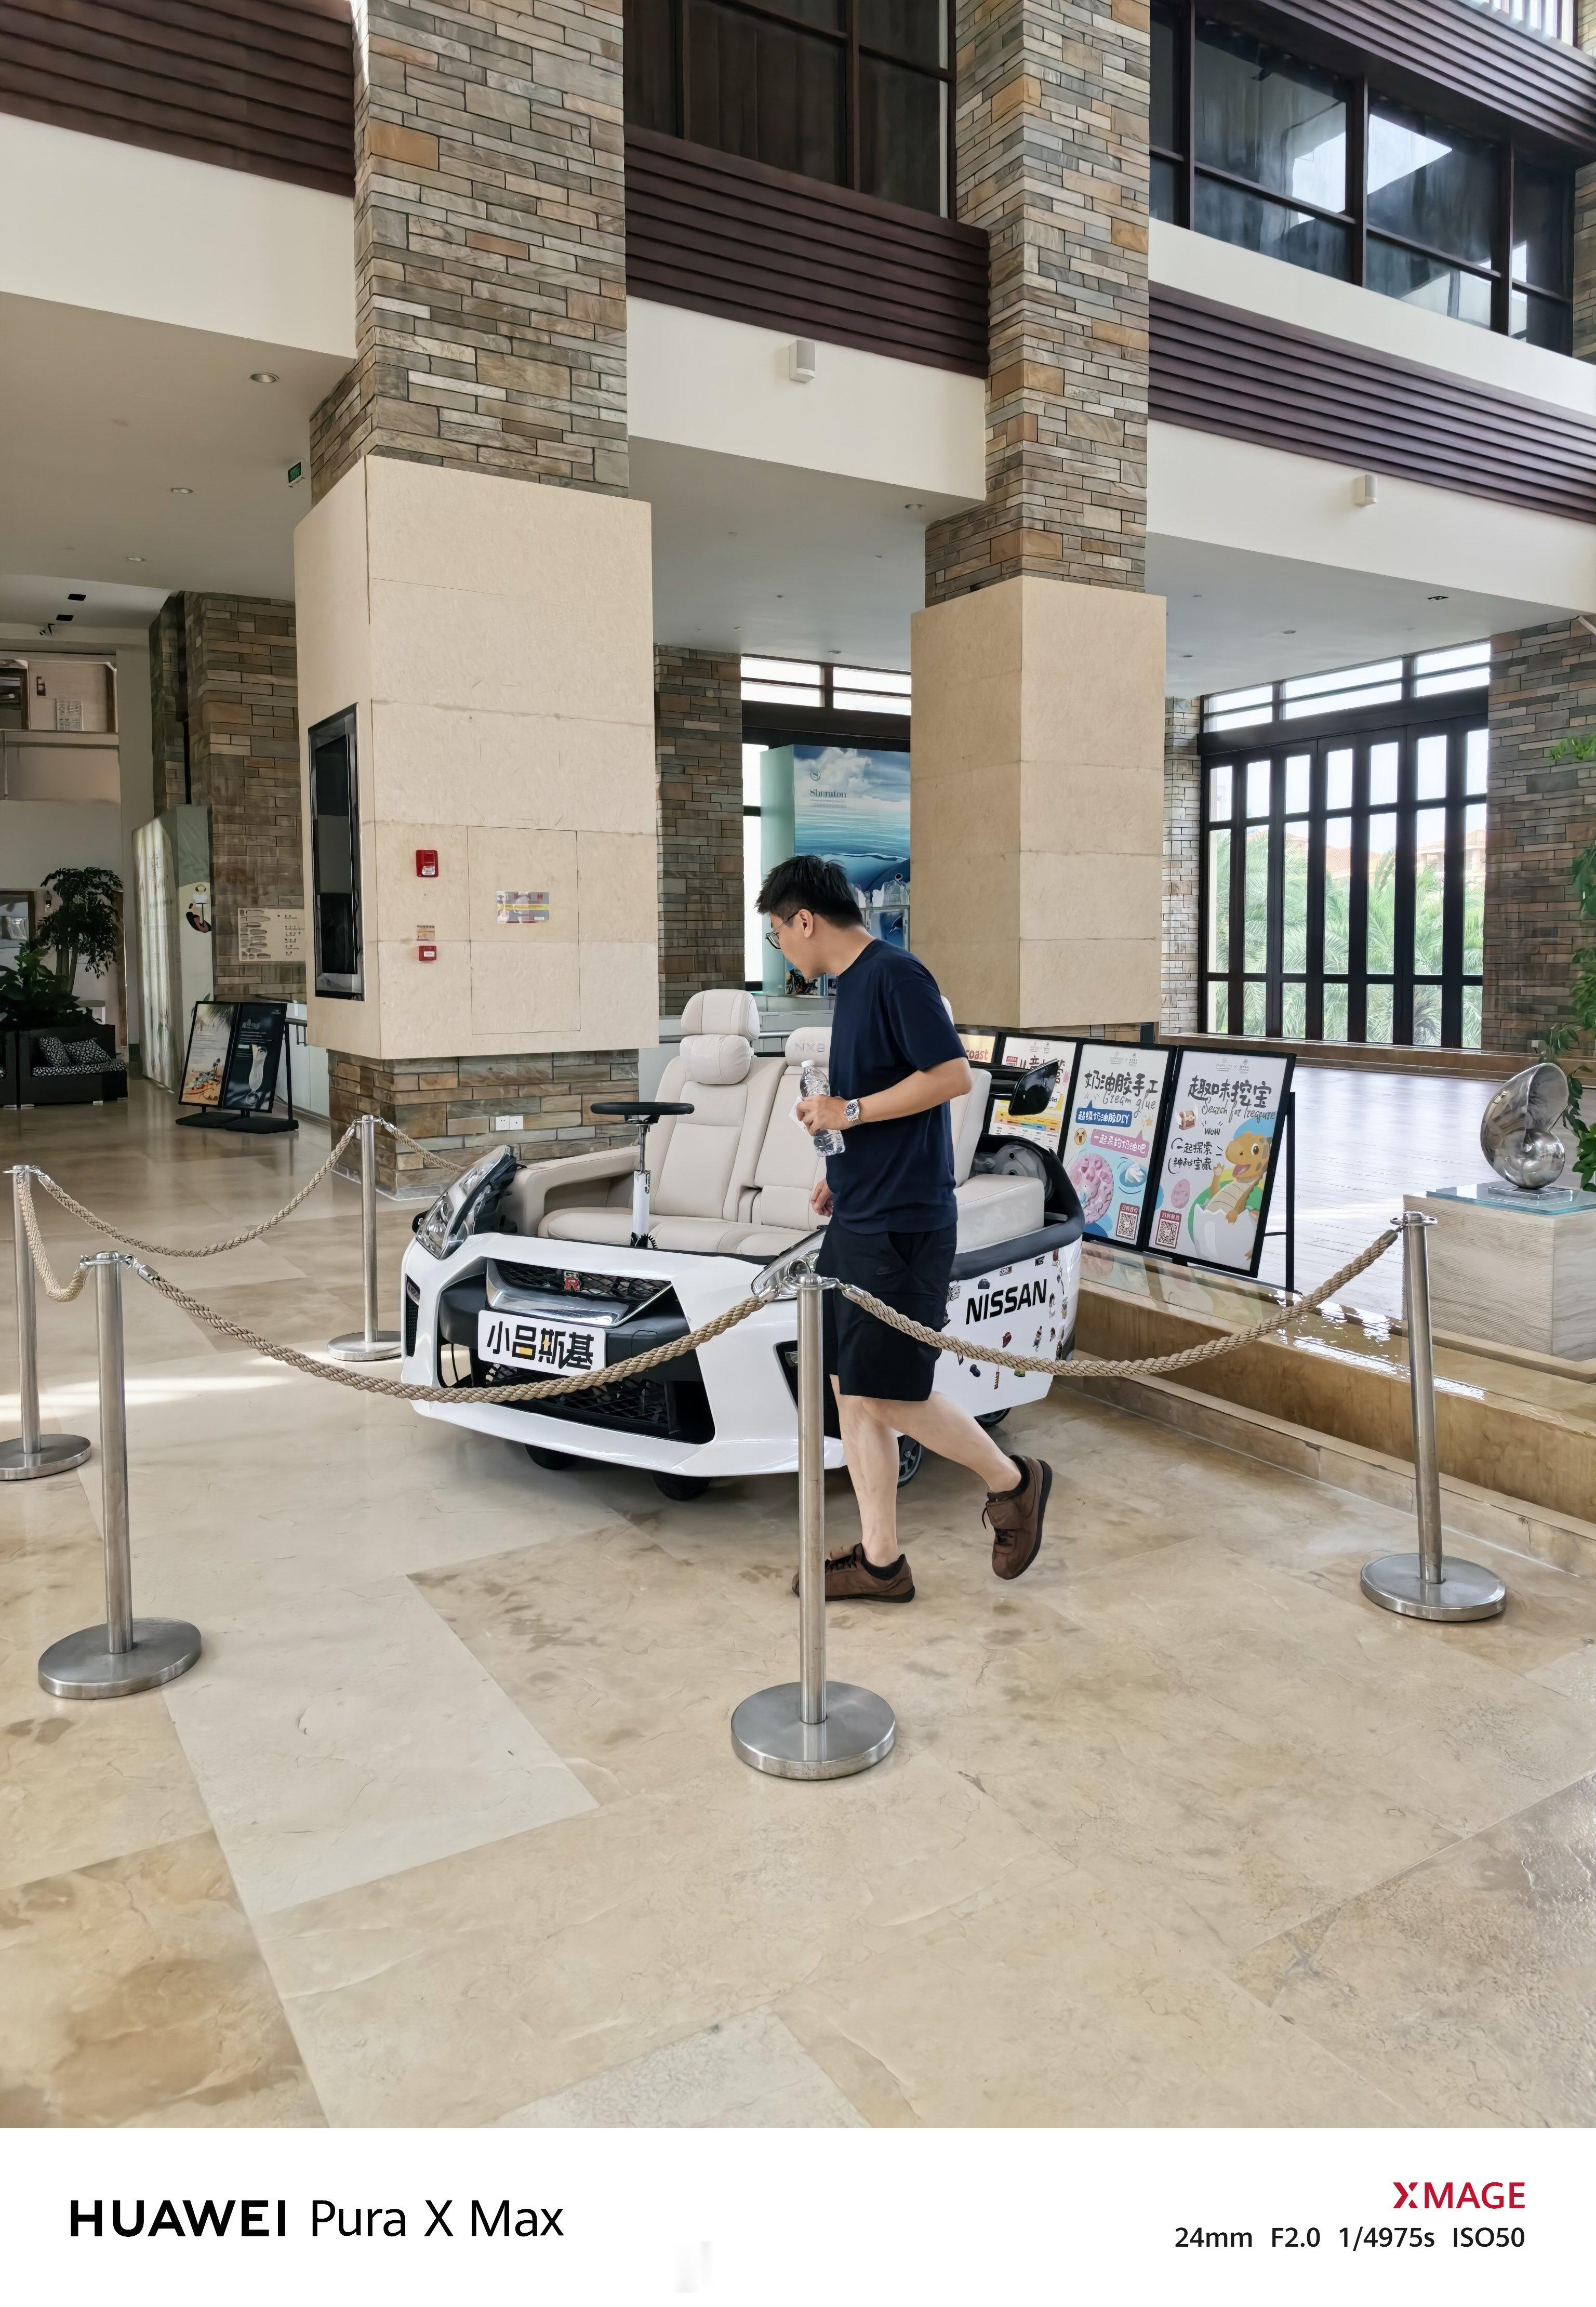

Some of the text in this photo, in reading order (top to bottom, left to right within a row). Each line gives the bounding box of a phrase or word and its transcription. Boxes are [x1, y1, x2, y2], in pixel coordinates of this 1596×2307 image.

[1084, 1070, 1158, 1097] 奶油胶手工
[1188, 1075, 1272, 1108] 趣味挖宝
[1078, 1111, 1130, 1124] 超级奶油胶DIY
[1229, 1101, 1242, 1123] for
[1094, 1134, 1146, 1154] 一起来约奶油吧
[1176, 1141, 1212, 1155] 一起探索
[1173, 1157, 1212, 1170] 神秘宝藏
[966, 1279, 1047, 1324] NISSAN
[486, 1321, 594, 1370] 小吕斯基
